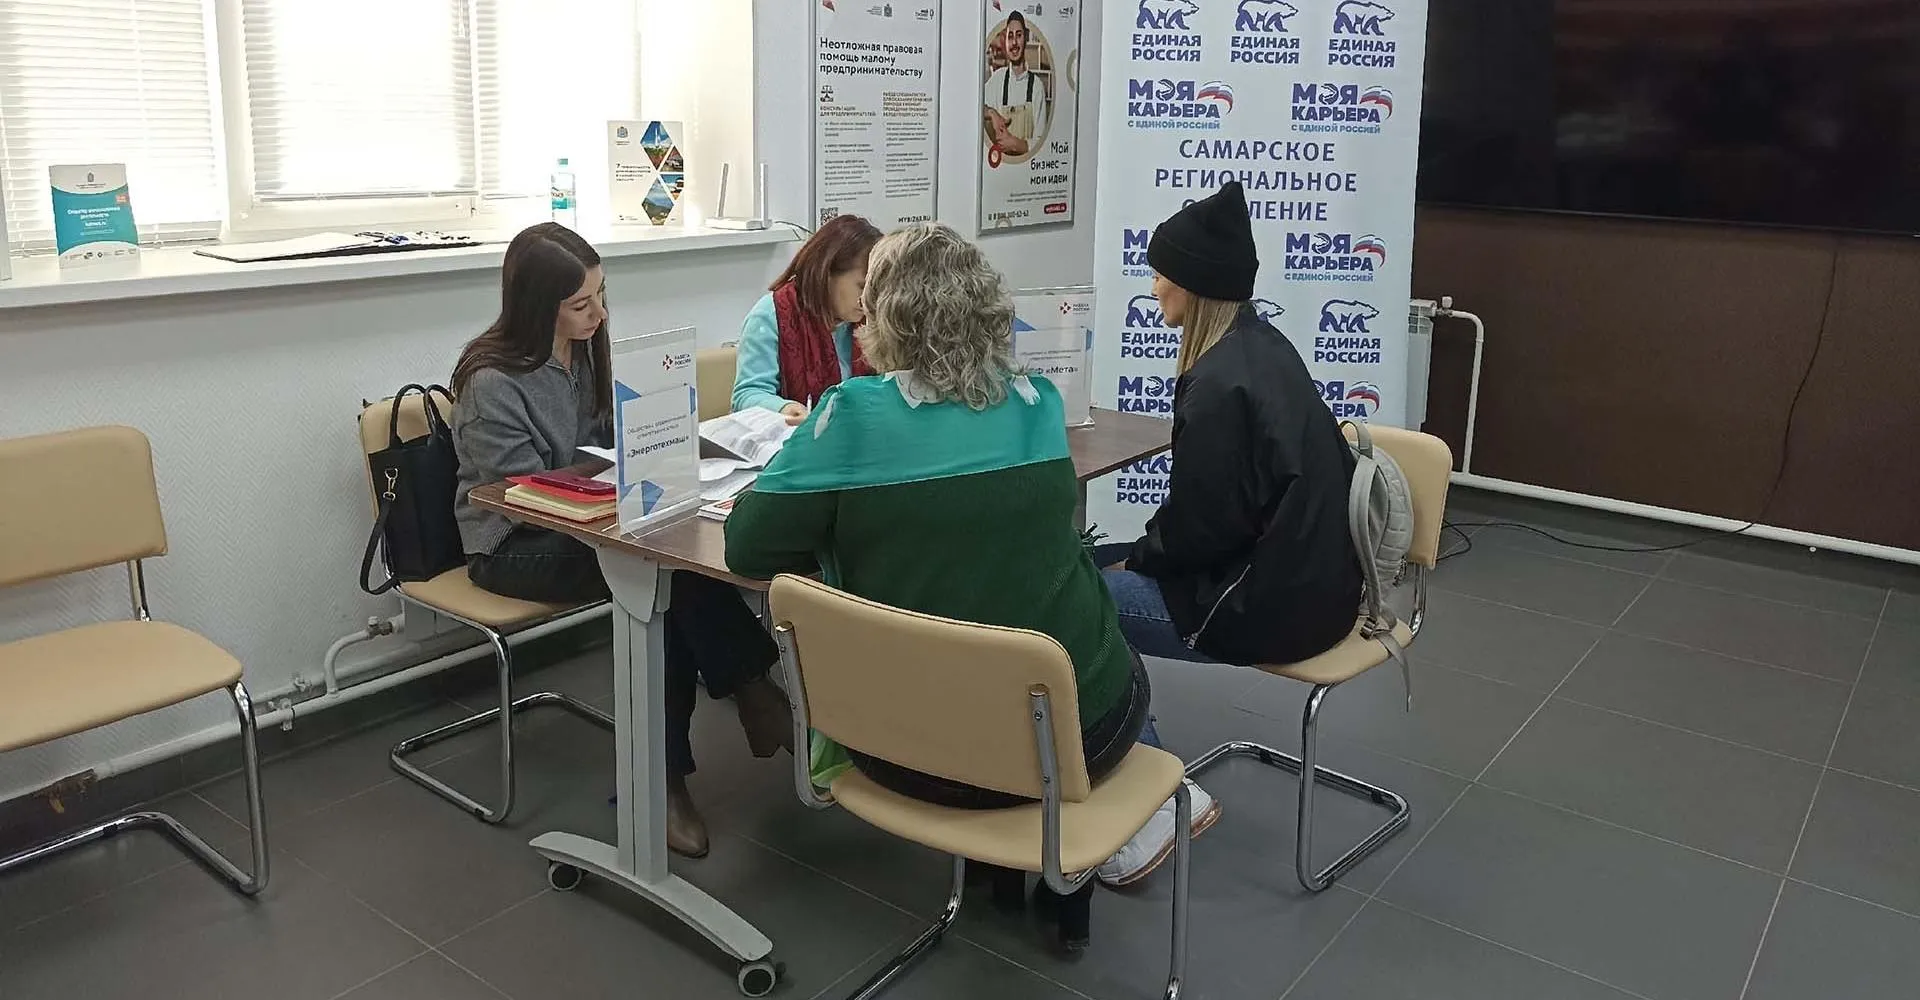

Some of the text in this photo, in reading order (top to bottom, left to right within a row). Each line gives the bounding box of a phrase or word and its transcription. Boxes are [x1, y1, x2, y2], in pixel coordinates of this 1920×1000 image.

[820, 37, 923, 54] Неотложная правовая
[1132, 34, 1201, 47] ЕДИНАЯ
[1231, 36, 1300, 49] ЕДИНАЯ
[1329, 40, 1395, 53] ЕДИНАЯ
[820, 53, 896, 66] помощь малому
[1132, 48, 1201, 62] РОССИЯ
[1230, 51, 1299, 64] РОССИЯ
[1328, 53, 1395, 68] РОССИЯ
[820, 64, 923, 78] предпринимательству
[1129, 79, 1196, 101] МОЯ
[1292, 83, 1359, 106] МОЯ
[1128, 102, 1220, 119] КАРЬЕРА
[1291, 106, 1381, 123] КАРЬЕРА
[1136, 120, 1176, 129] ЕДИНОЙ
[1177, 121, 1220, 130] РОССИЕЙ
[1300, 123, 1339, 133] ЕДИНОЙ
[1340, 125, 1381, 134] РОССИЕЙ
[1050, 142, 1069, 154] Мой
[1180, 140, 1336, 162] САМАРСКОЕ
[1030, 158, 1059, 170] бизнес
[1048, 174, 1068, 184] идеи
[1156, 168, 1358, 193] РЕГИОНАЛЬНОЕ
[1286, 233, 1352, 255] МОЯ
[1285, 256, 1374, 272] КАРЬЕРА
[1292, 272, 1331, 281] ЕДИНОЙ
[1332, 273, 1374, 282] РОССИЕЙ
[1315, 337, 1381, 350] ЕДИНАЯ
[1121, 347, 1178, 359] РОССИ
[1314, 350, 1381, 364] РОССИЯ
[1118, 398, 1175, 413] КАРЬ
[627, 435, 690, 458] «Энерготехмаш»
[1117, 478, 1171, 491] ЕДИНА
